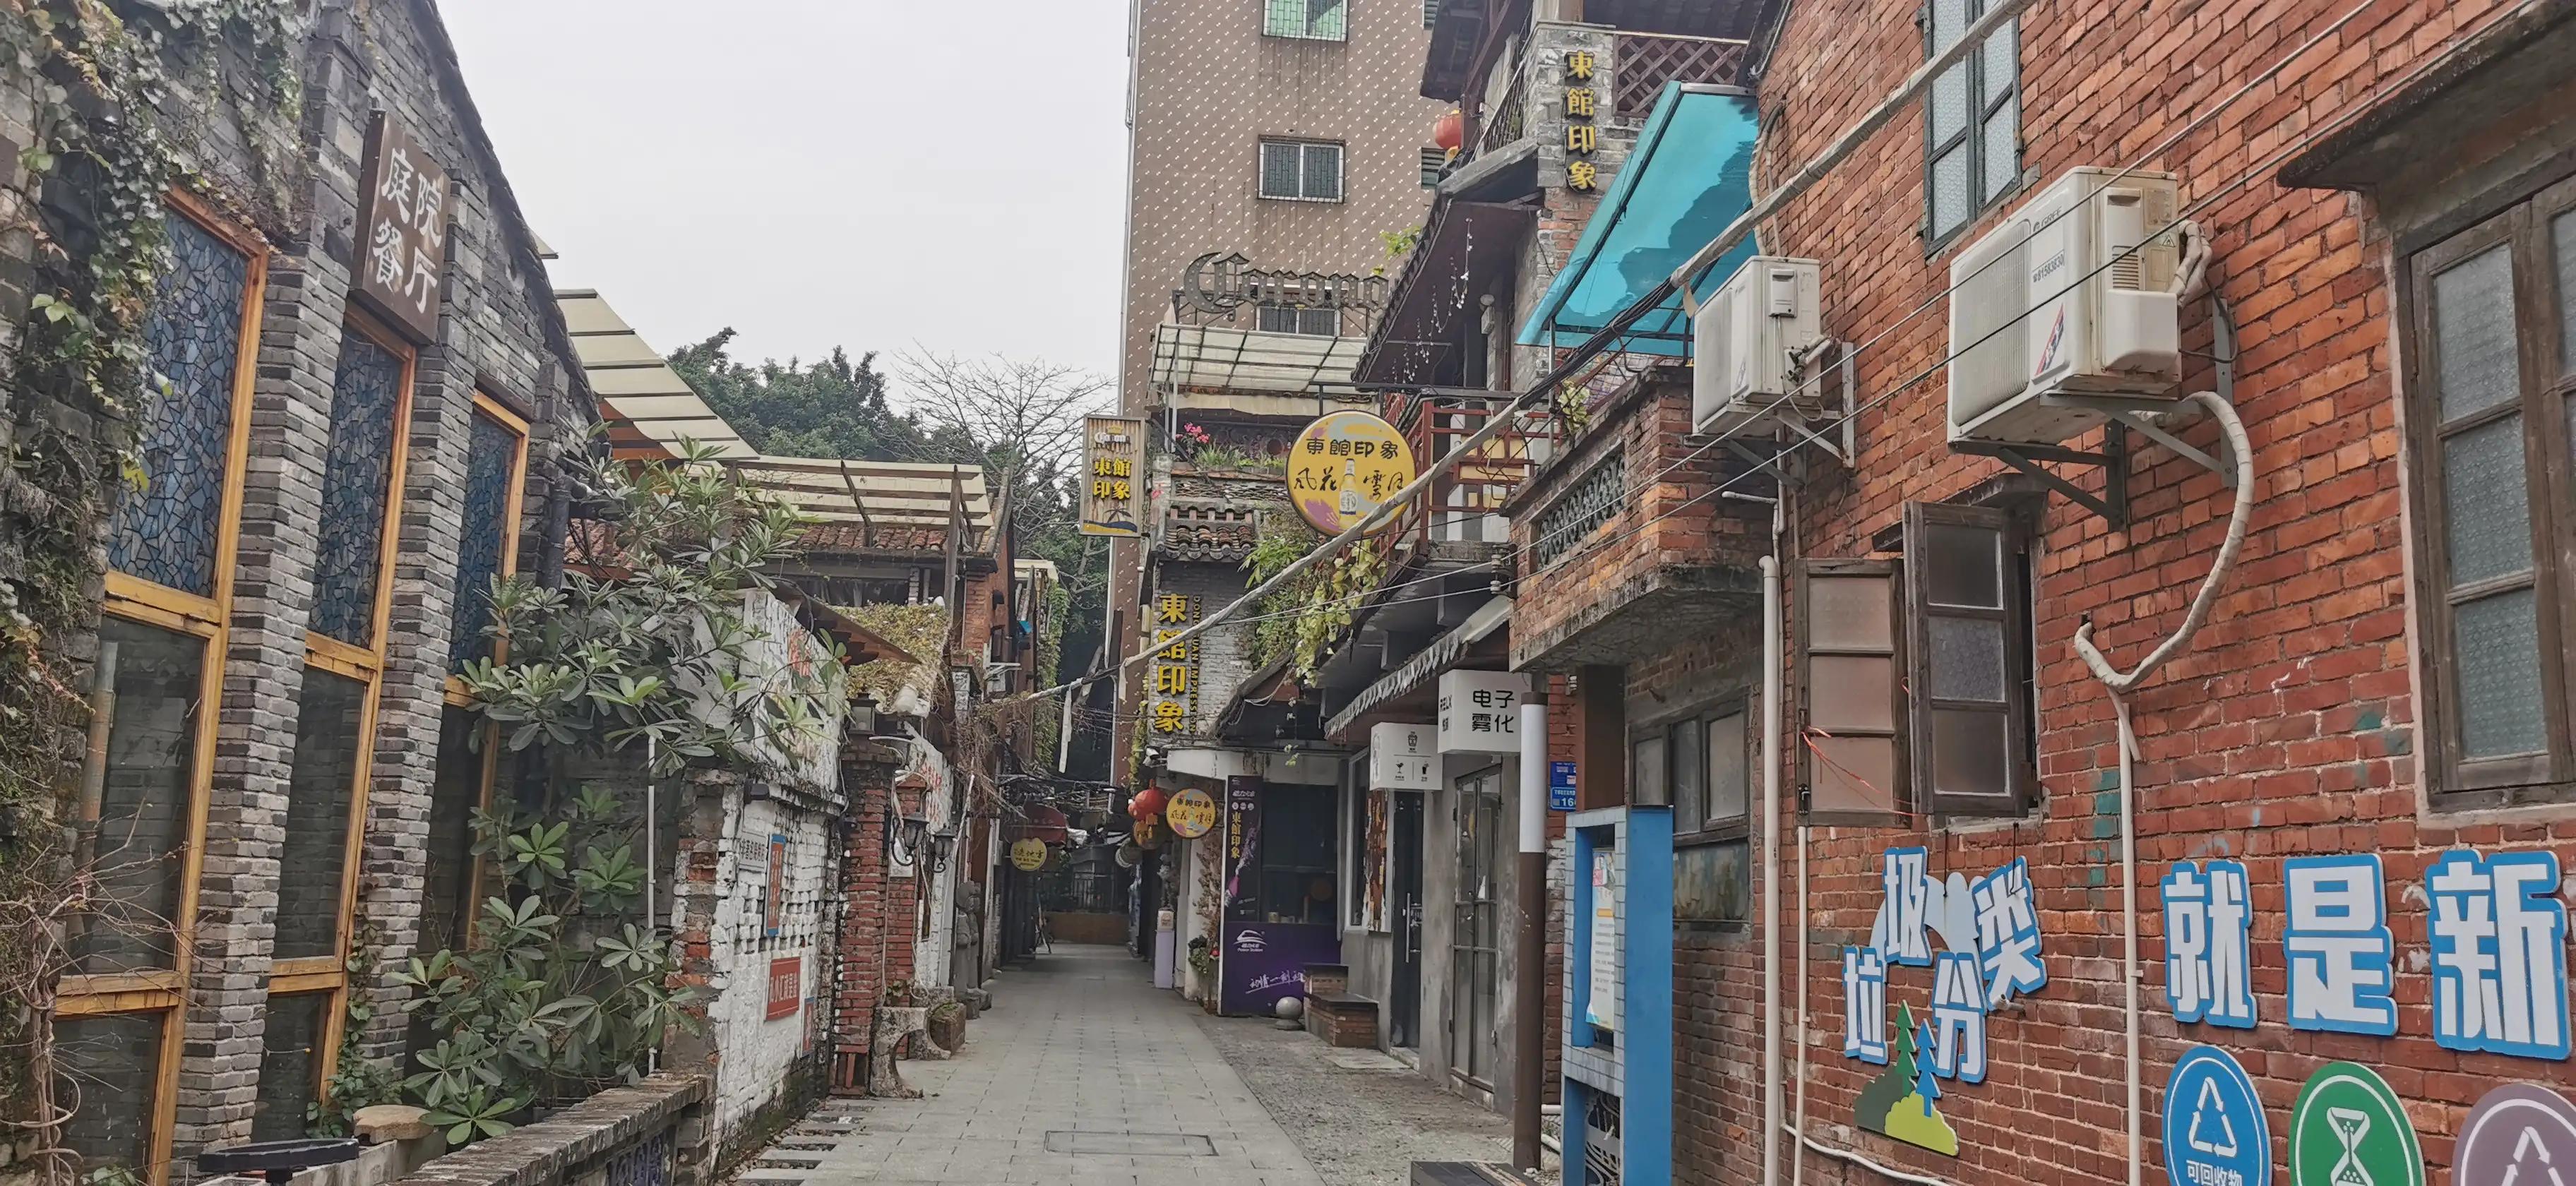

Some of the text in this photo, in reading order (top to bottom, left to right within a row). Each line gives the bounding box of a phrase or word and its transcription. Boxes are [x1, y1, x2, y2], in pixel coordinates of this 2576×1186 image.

[1566, 50, 1597, 191] 東館印象
[381, 147, 443, 248] 庭院
[372, 216, 439, 314] 餐厅
[1183, 251, 1389, 322] Corona
[1094, 457, 1132, 477] 東館
[1306, 437, 1399, 460] 東館印象
[1093, 479, 1131, 501] 印象
[1155, 592, 1188, 732] 東館印象
[1189, 666, 1199, 733] IMPRESSION
[1472, 689, 1515, 709] 电子
[1472, 713, 1515, 733] 雾化
[1561, 797, 1576, 807] 16
[1231, 812, 1241, 859] 東館印象
[2164, 858, 2562, 1048] 就是新
[2186, 1159, 2243, 1186] 可回收物
